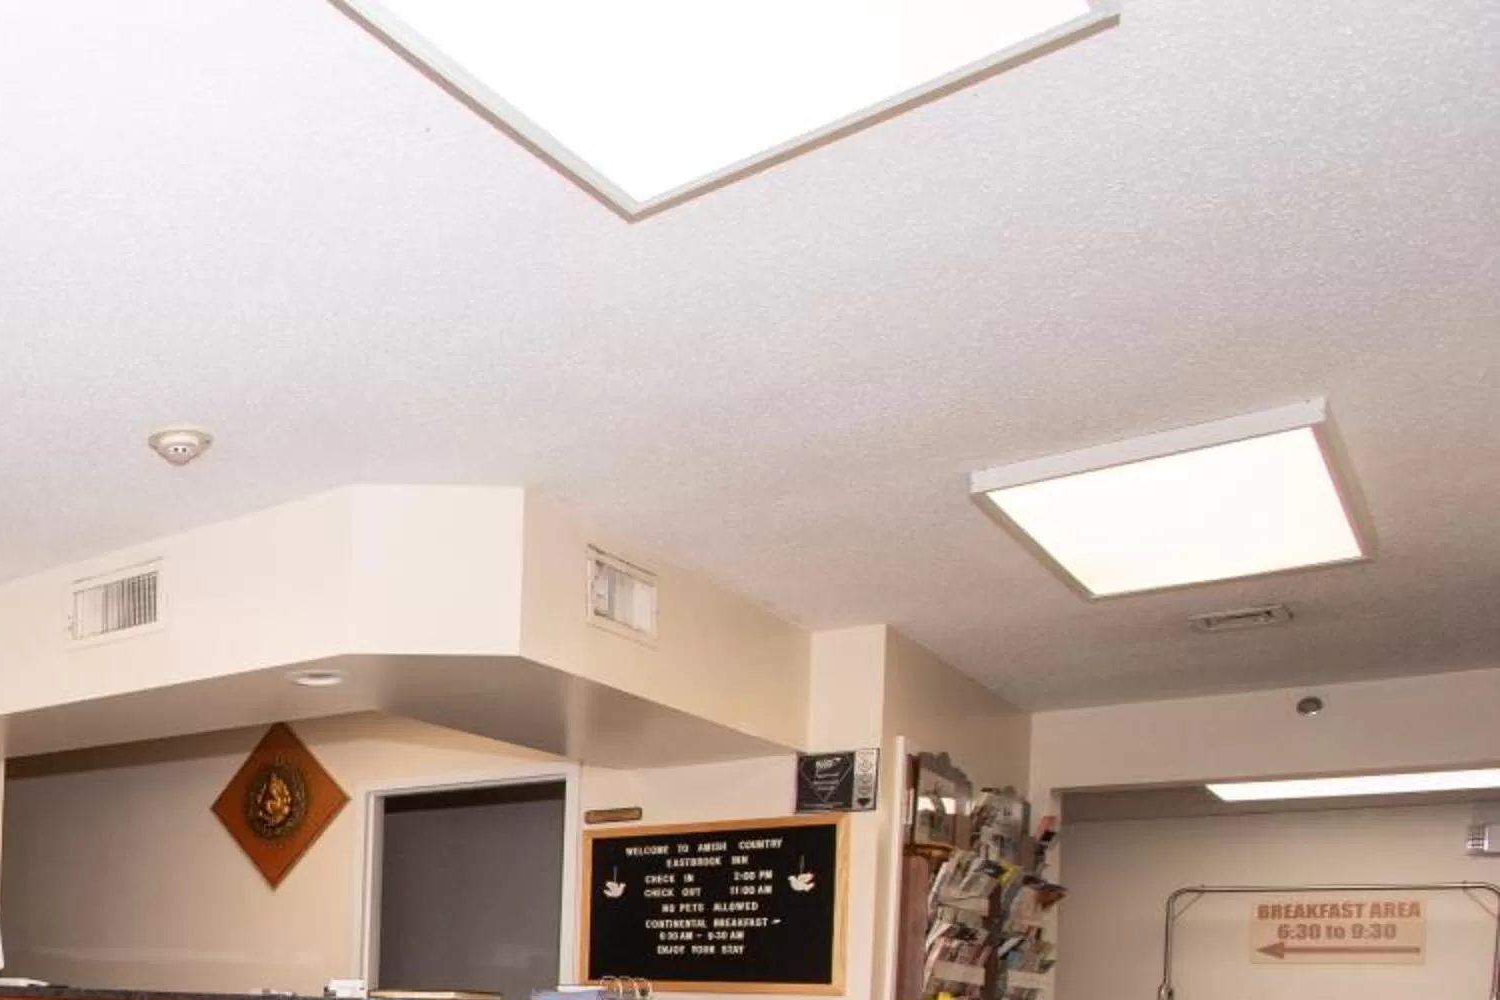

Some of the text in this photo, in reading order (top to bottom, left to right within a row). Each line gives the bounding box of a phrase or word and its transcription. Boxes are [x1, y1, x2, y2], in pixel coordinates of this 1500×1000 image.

[625, 845, 670, 857] WELCOME
[677, 843, 689, 854] TO
[738, 837, 784, 850] COUNTRY
[644, 873, 695, 885] CHECK IN
[758, 870, 774, 880] PM
[644, 887, 702, 898] CHECK OUT
[757, 884, 774, 895] AM
[661, 901, 760, 913] NO PETS ALLOWED
[1256, 901, 1422, 920] BREAKFAST AREA
[645, 918, 707, 929] CONTINENTAL
[713, 917, 769, 928] BREAKFAST
[679, 931, 694, 941] AM
[729, 930, 746, 941] AM
[1277, 923, 1322, 940] 6:30
[1325, 924, 1346, 939] to
